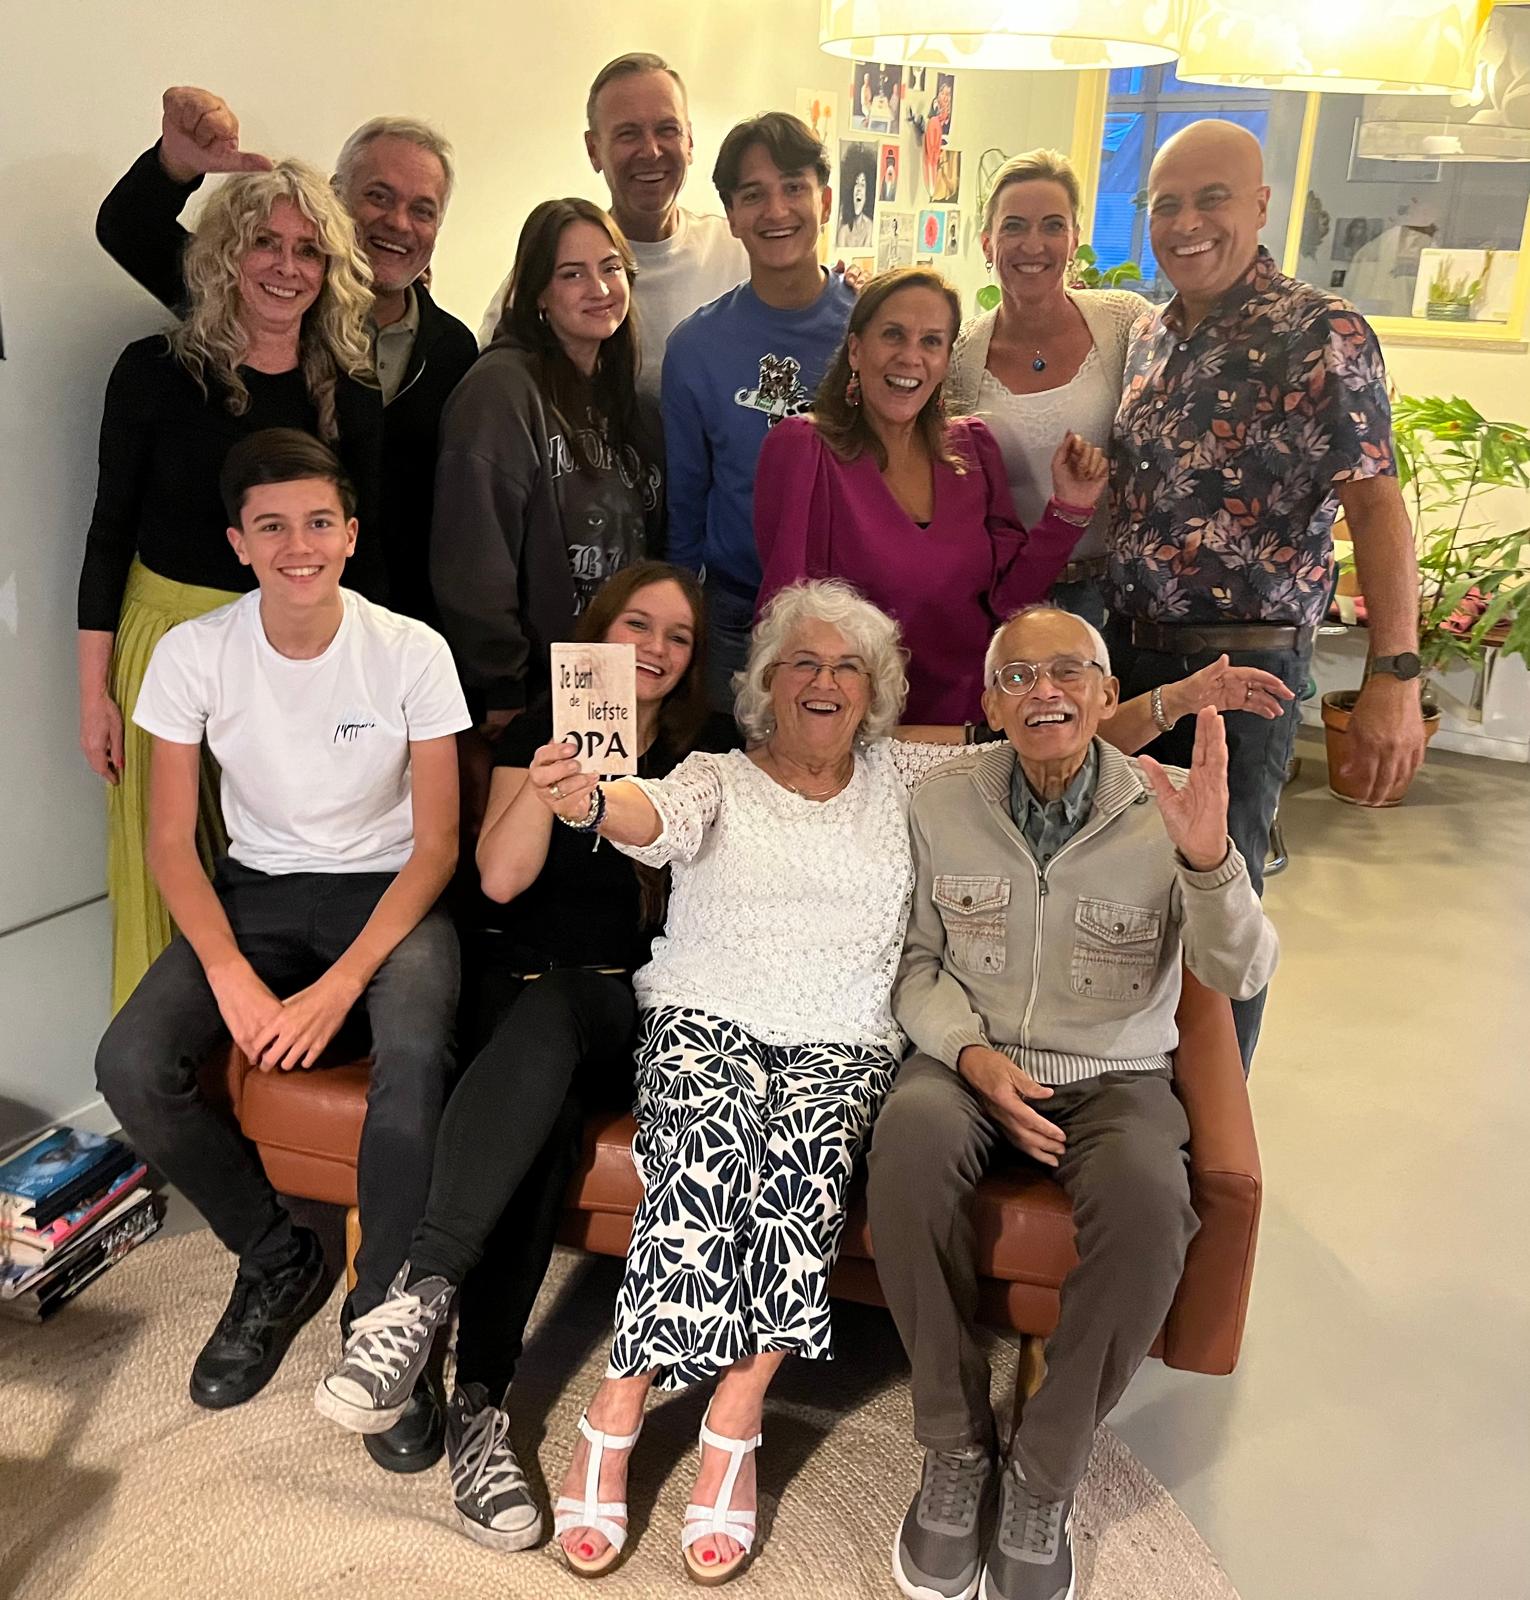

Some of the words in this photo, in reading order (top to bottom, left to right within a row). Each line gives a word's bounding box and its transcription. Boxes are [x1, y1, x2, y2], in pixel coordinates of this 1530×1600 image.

[560, 664, 571, 689] Je
[574, 664, 592, 689] bent
[569, 693, 580, 707] de
[588, 701, 628, 721] liefste
